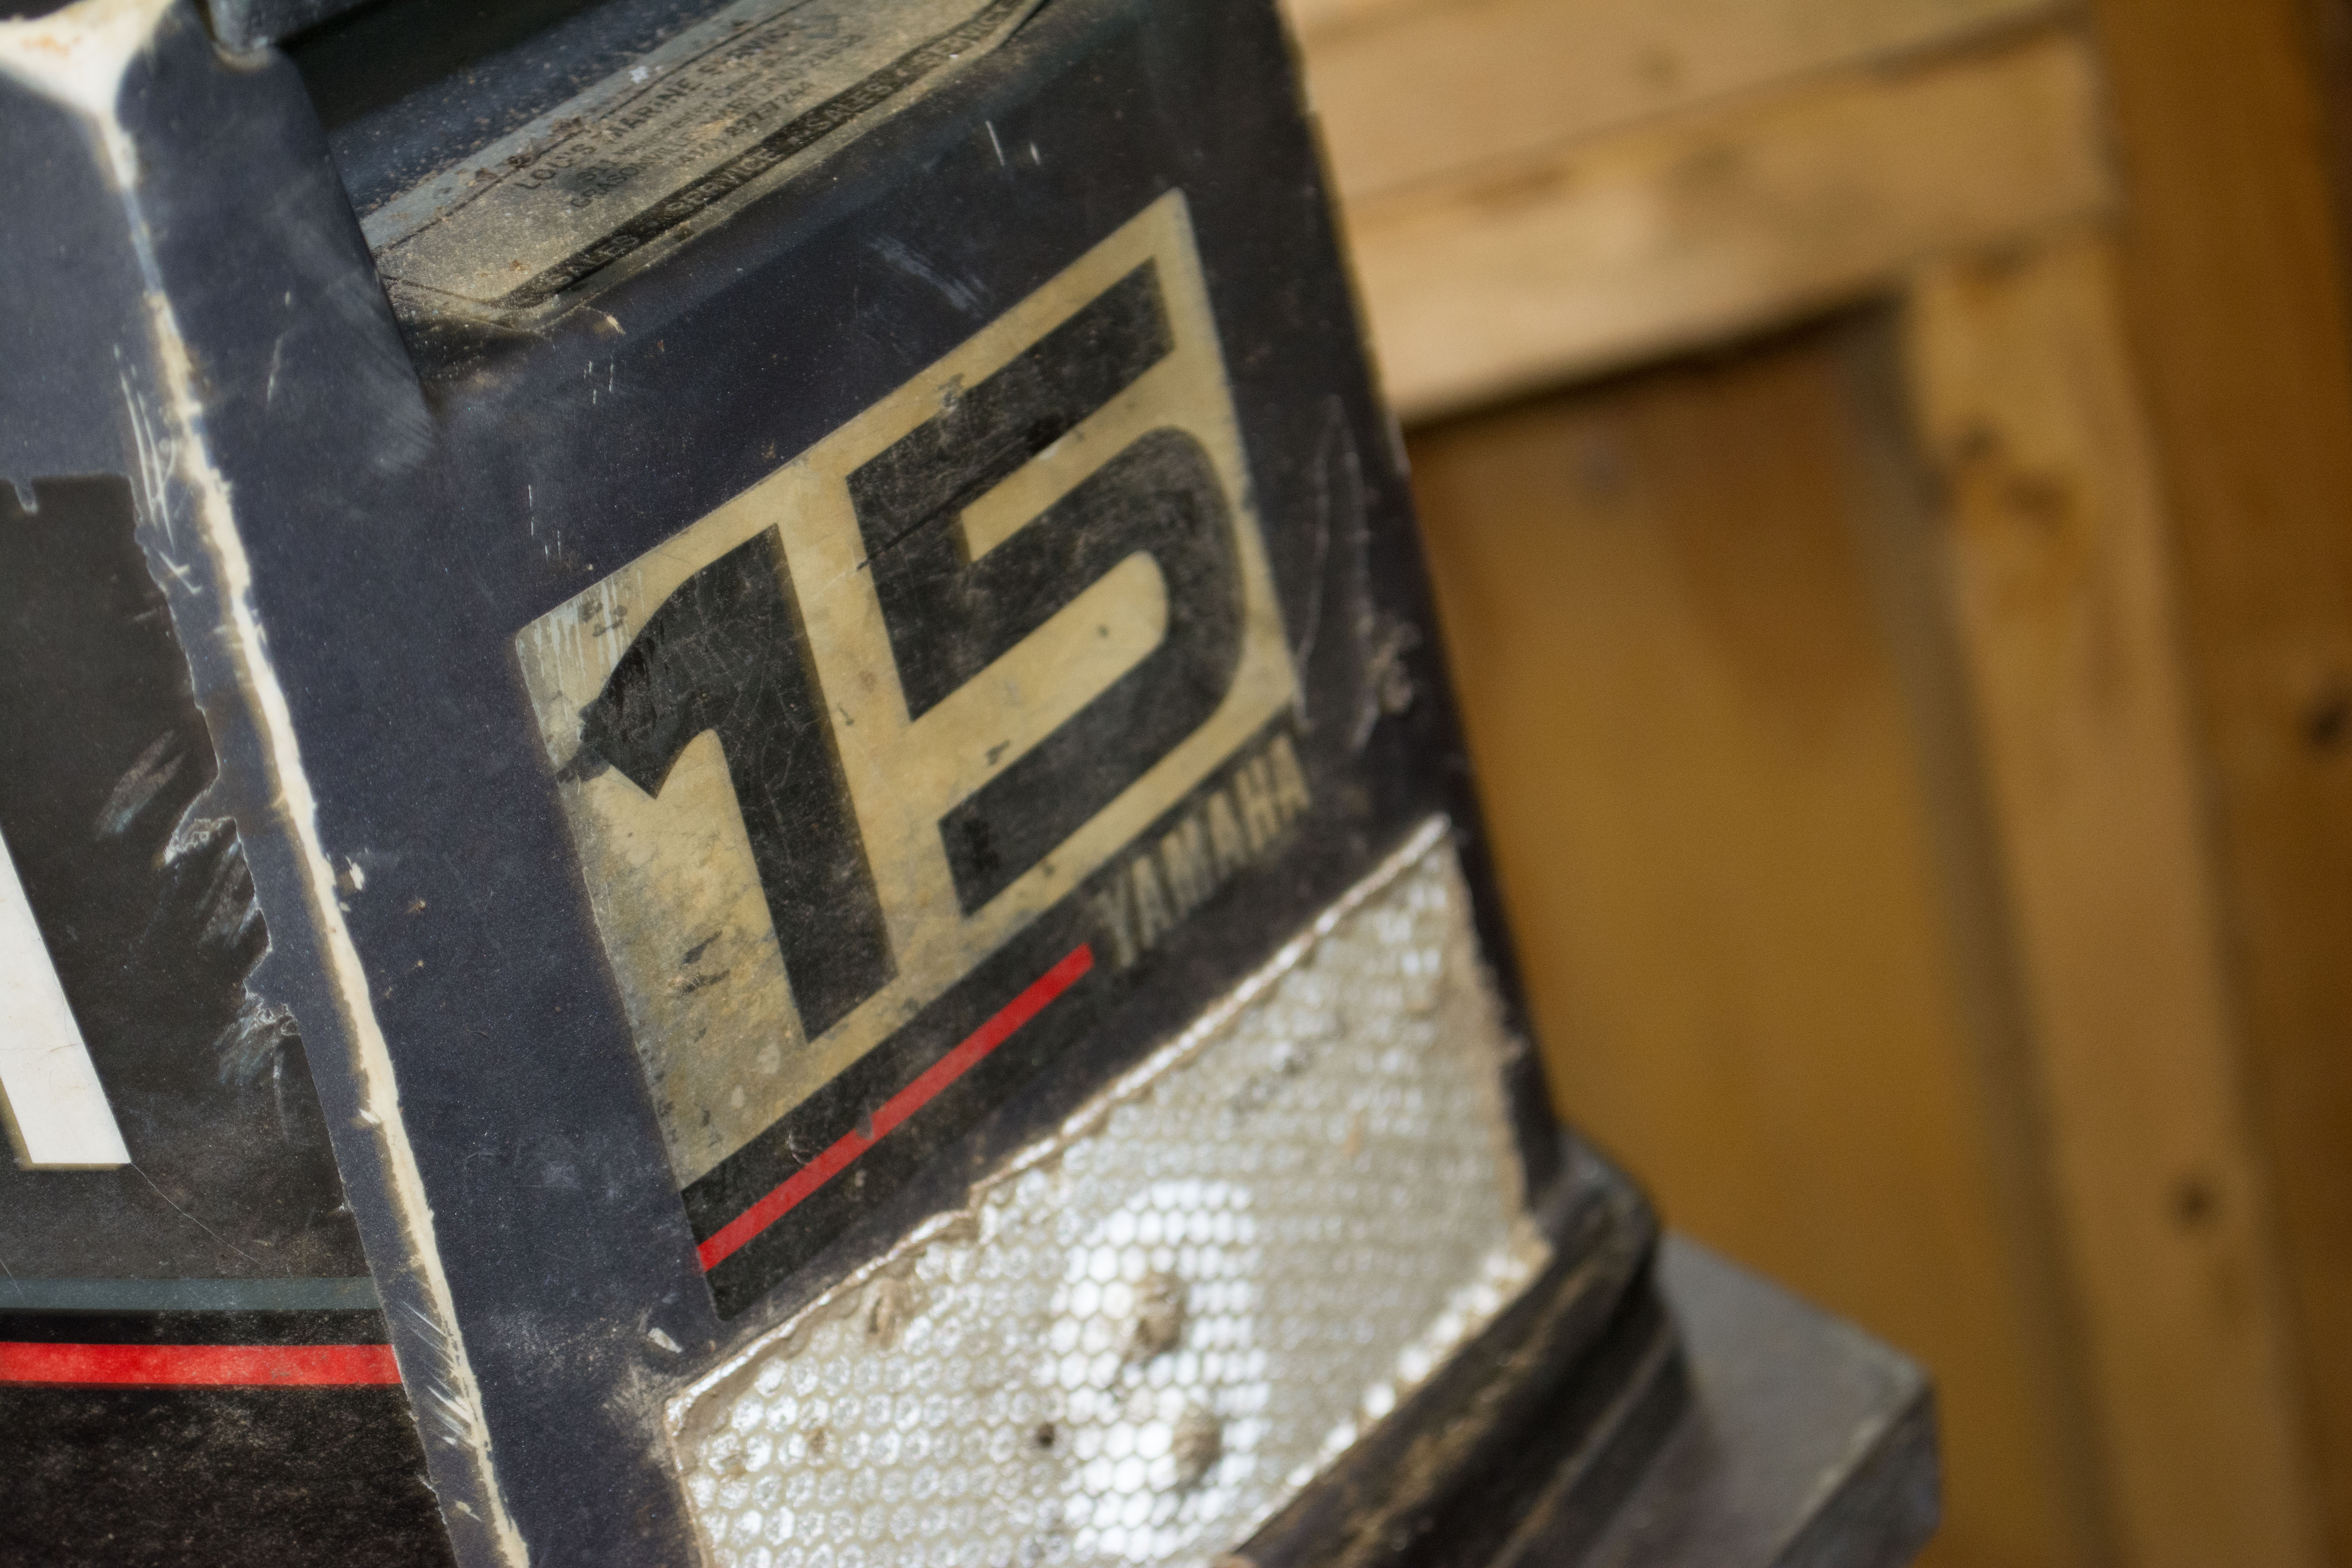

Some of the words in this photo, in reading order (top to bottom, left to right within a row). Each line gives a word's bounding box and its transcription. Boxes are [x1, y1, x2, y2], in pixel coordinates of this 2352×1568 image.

[604, 77, 703, 140] MARINE
[662, 147, 783, 216] SERVICE
[806, 81, 892, 131] SALES
[581, 258, 1247, 1043] 15
[1085, 734, 1310, 967] YAMAHA
